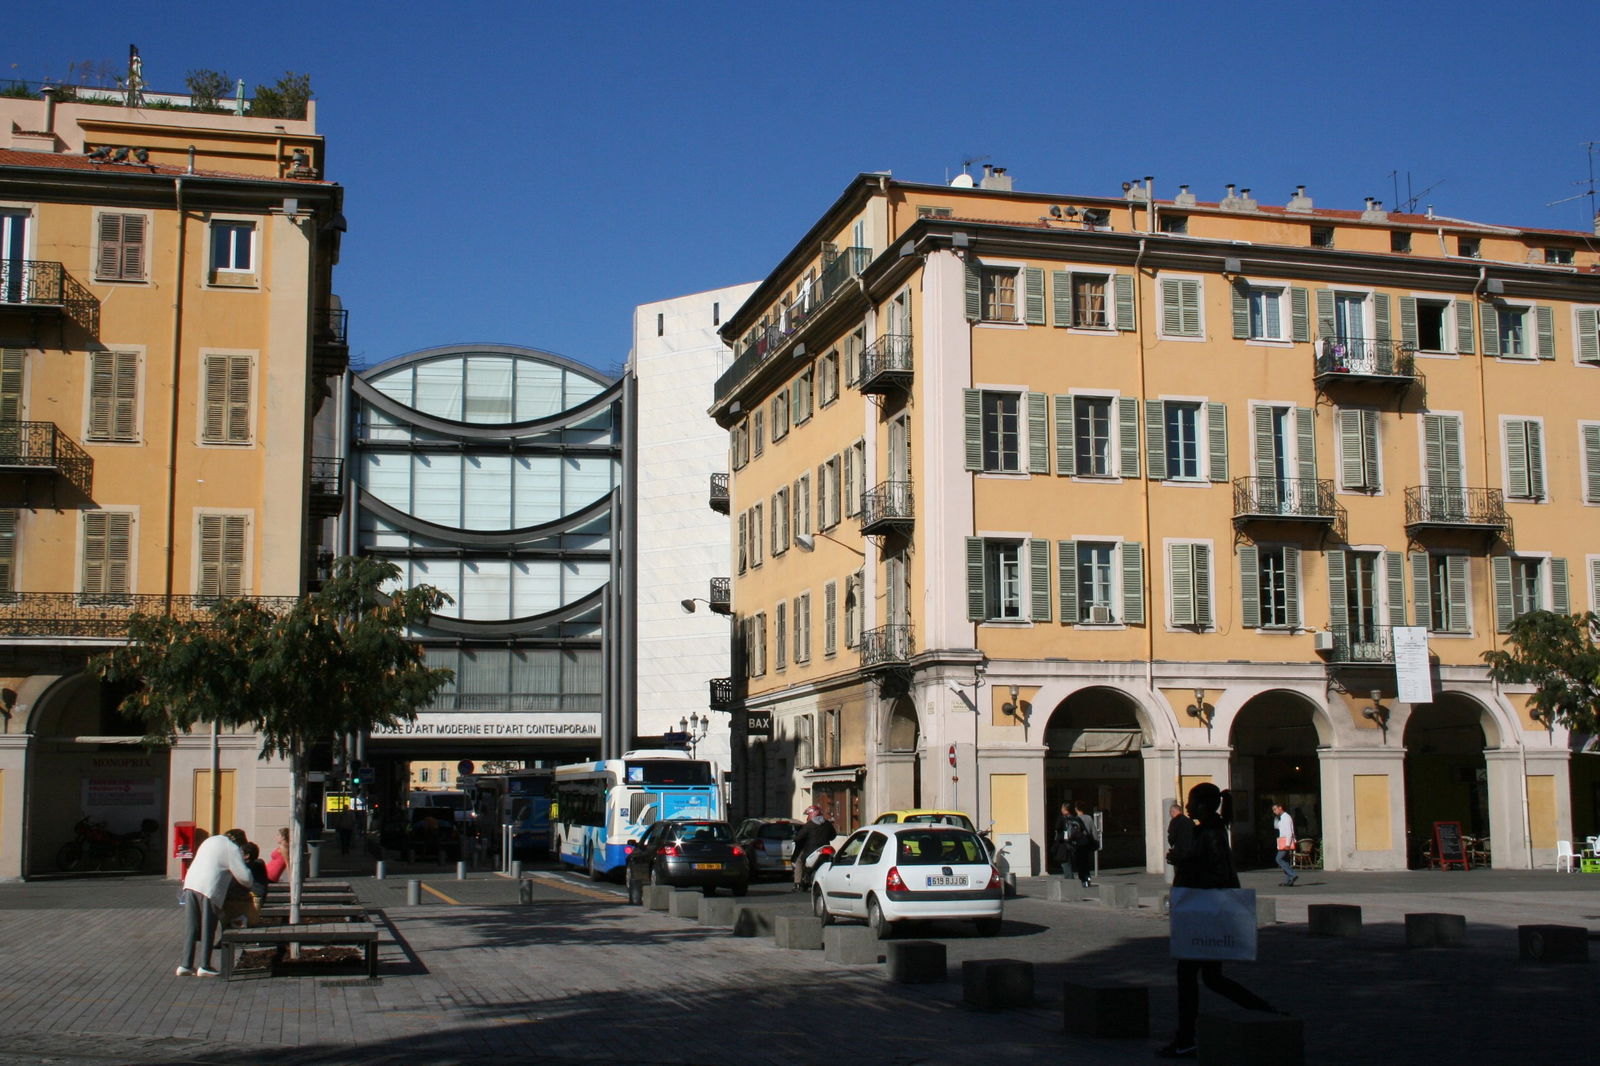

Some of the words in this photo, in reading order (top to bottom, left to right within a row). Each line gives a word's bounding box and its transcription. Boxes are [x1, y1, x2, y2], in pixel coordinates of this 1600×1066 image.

[748, 718, 770, 729] BAX
[405, 724, 435, 735] D'ART
[436, 724, 482, 735] MODERNE
[483, 724, 496, 735] ET
[496, 724, 524, 735] D'ART
[526, 724, 597, 735] CONTEMPORAIN
[93, 758, 152, 768] MONOPRIX
[1191, 935, 1235, 948] minelli
